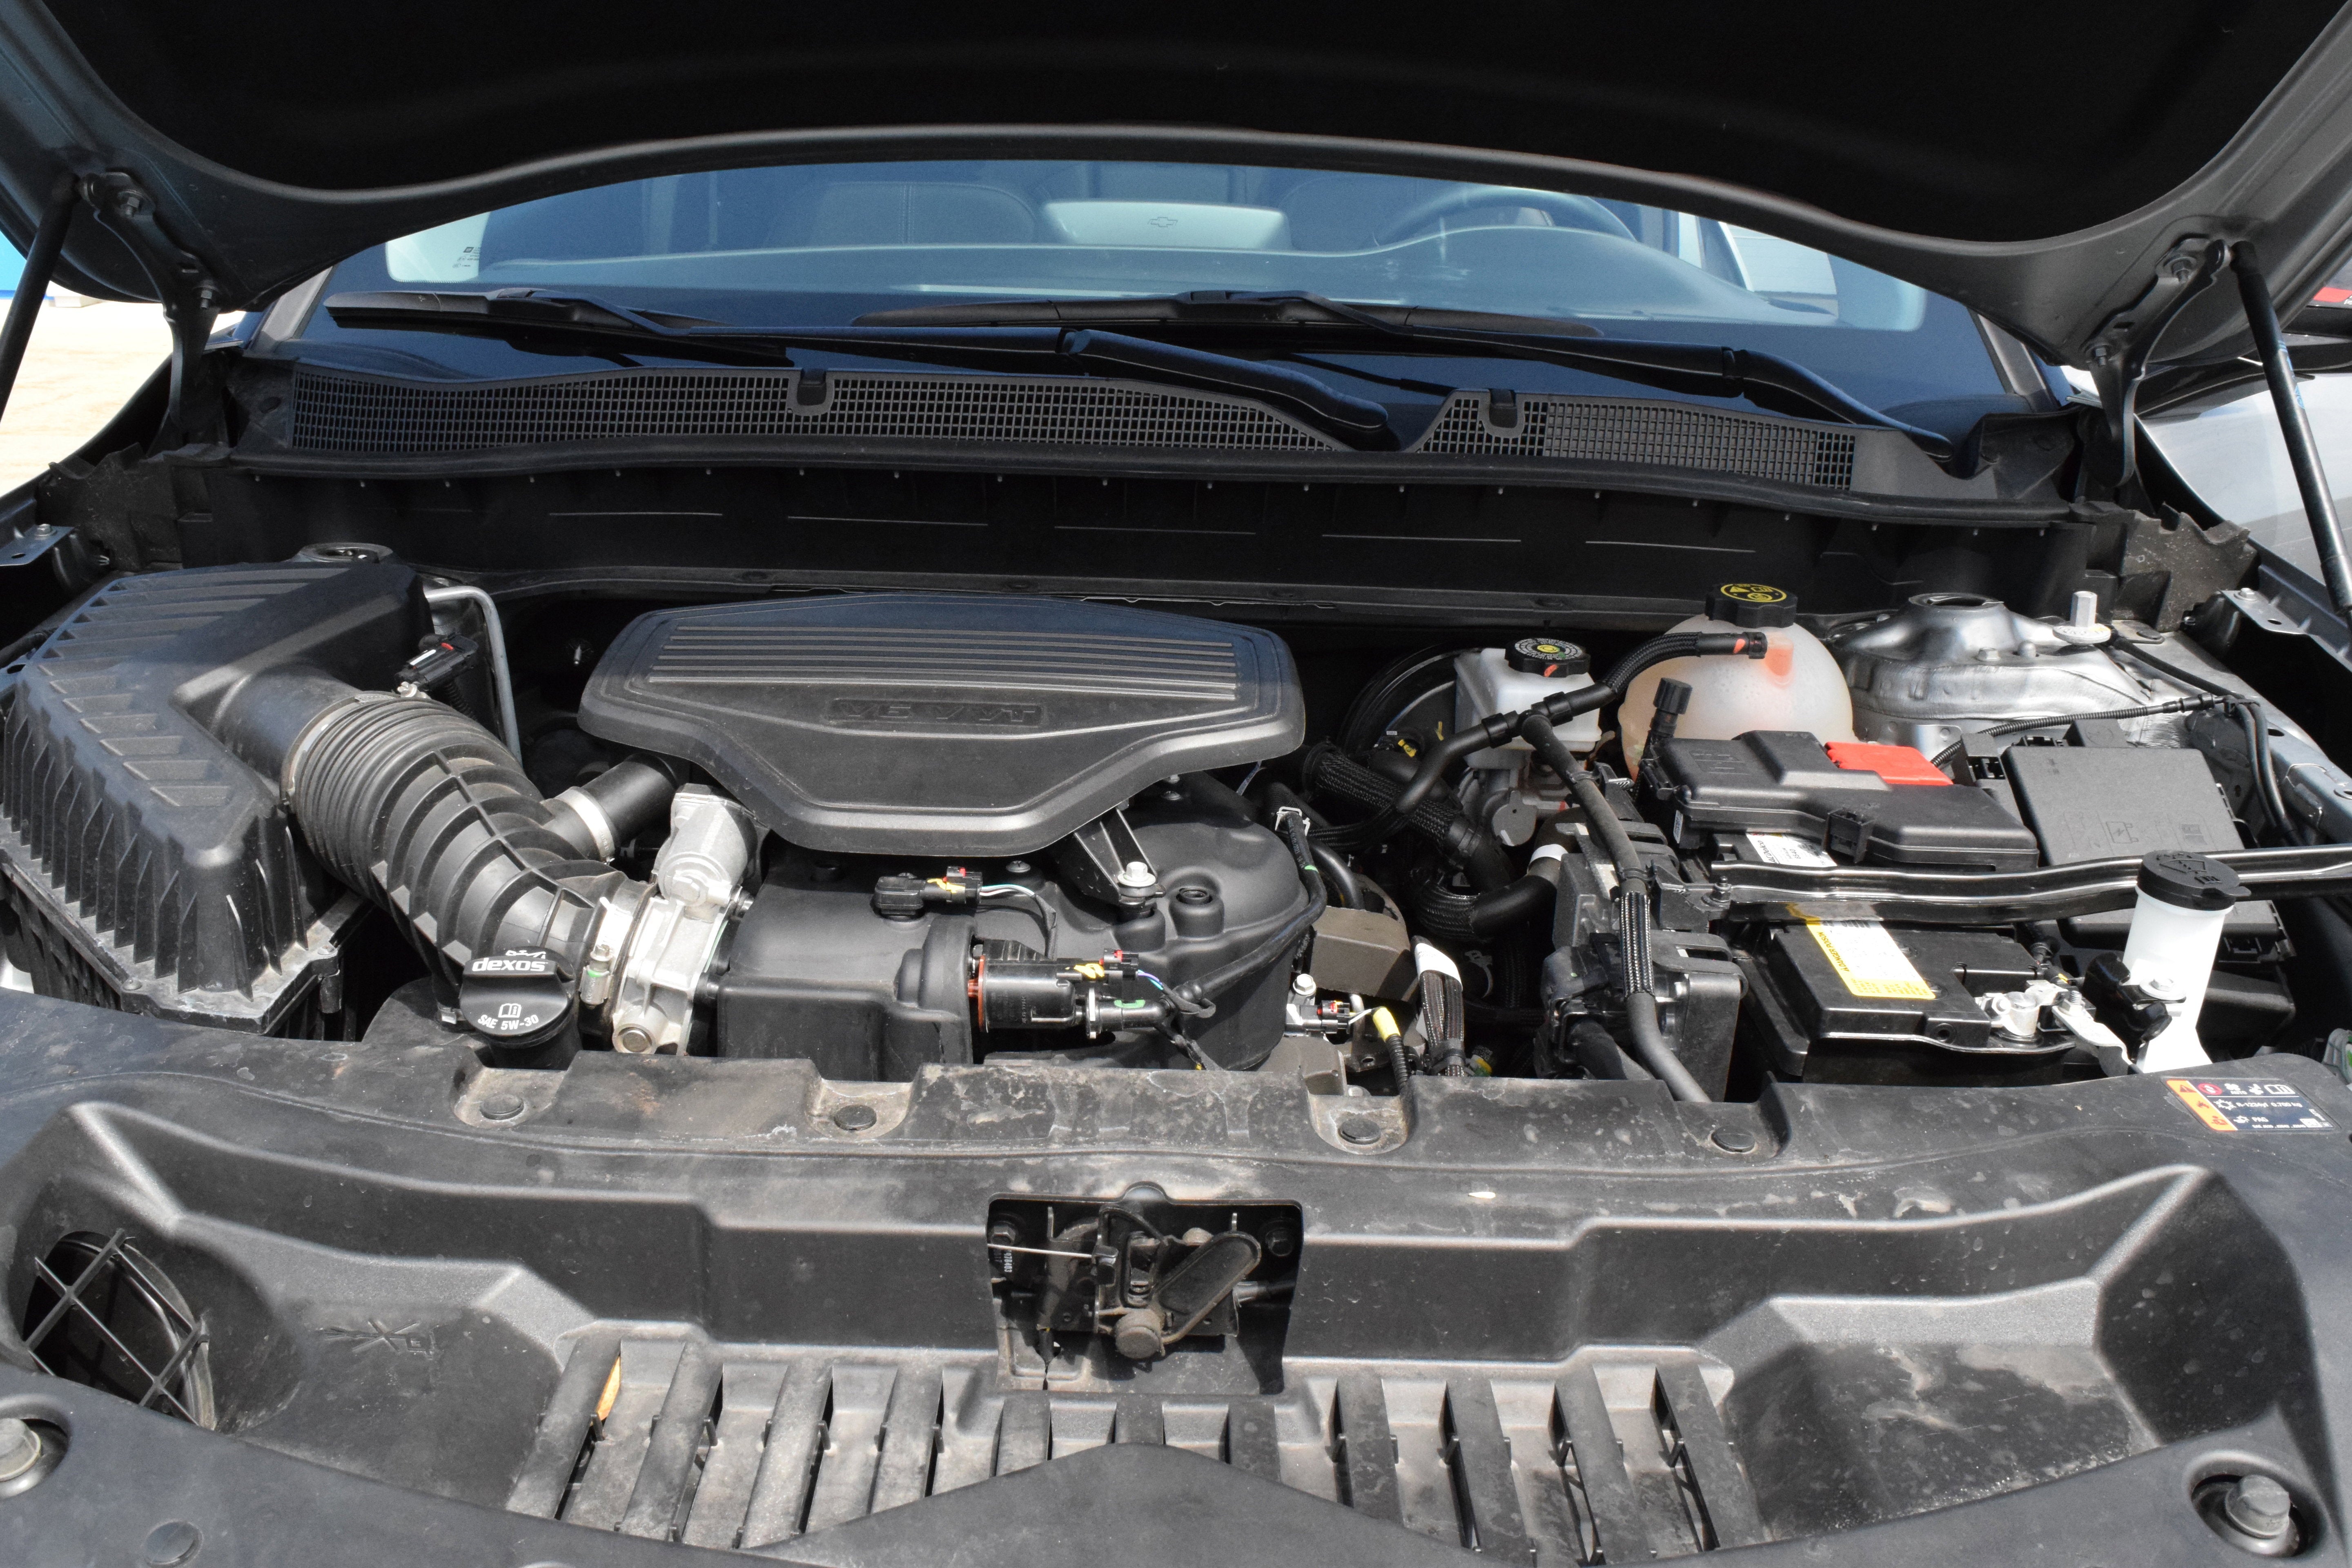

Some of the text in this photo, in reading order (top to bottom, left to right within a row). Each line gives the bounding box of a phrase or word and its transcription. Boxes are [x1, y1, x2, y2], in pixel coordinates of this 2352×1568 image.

[1816, 932, 1847, 967] DANGER POISON
[478, 1014, 539, 1030] SAE 5W-30
